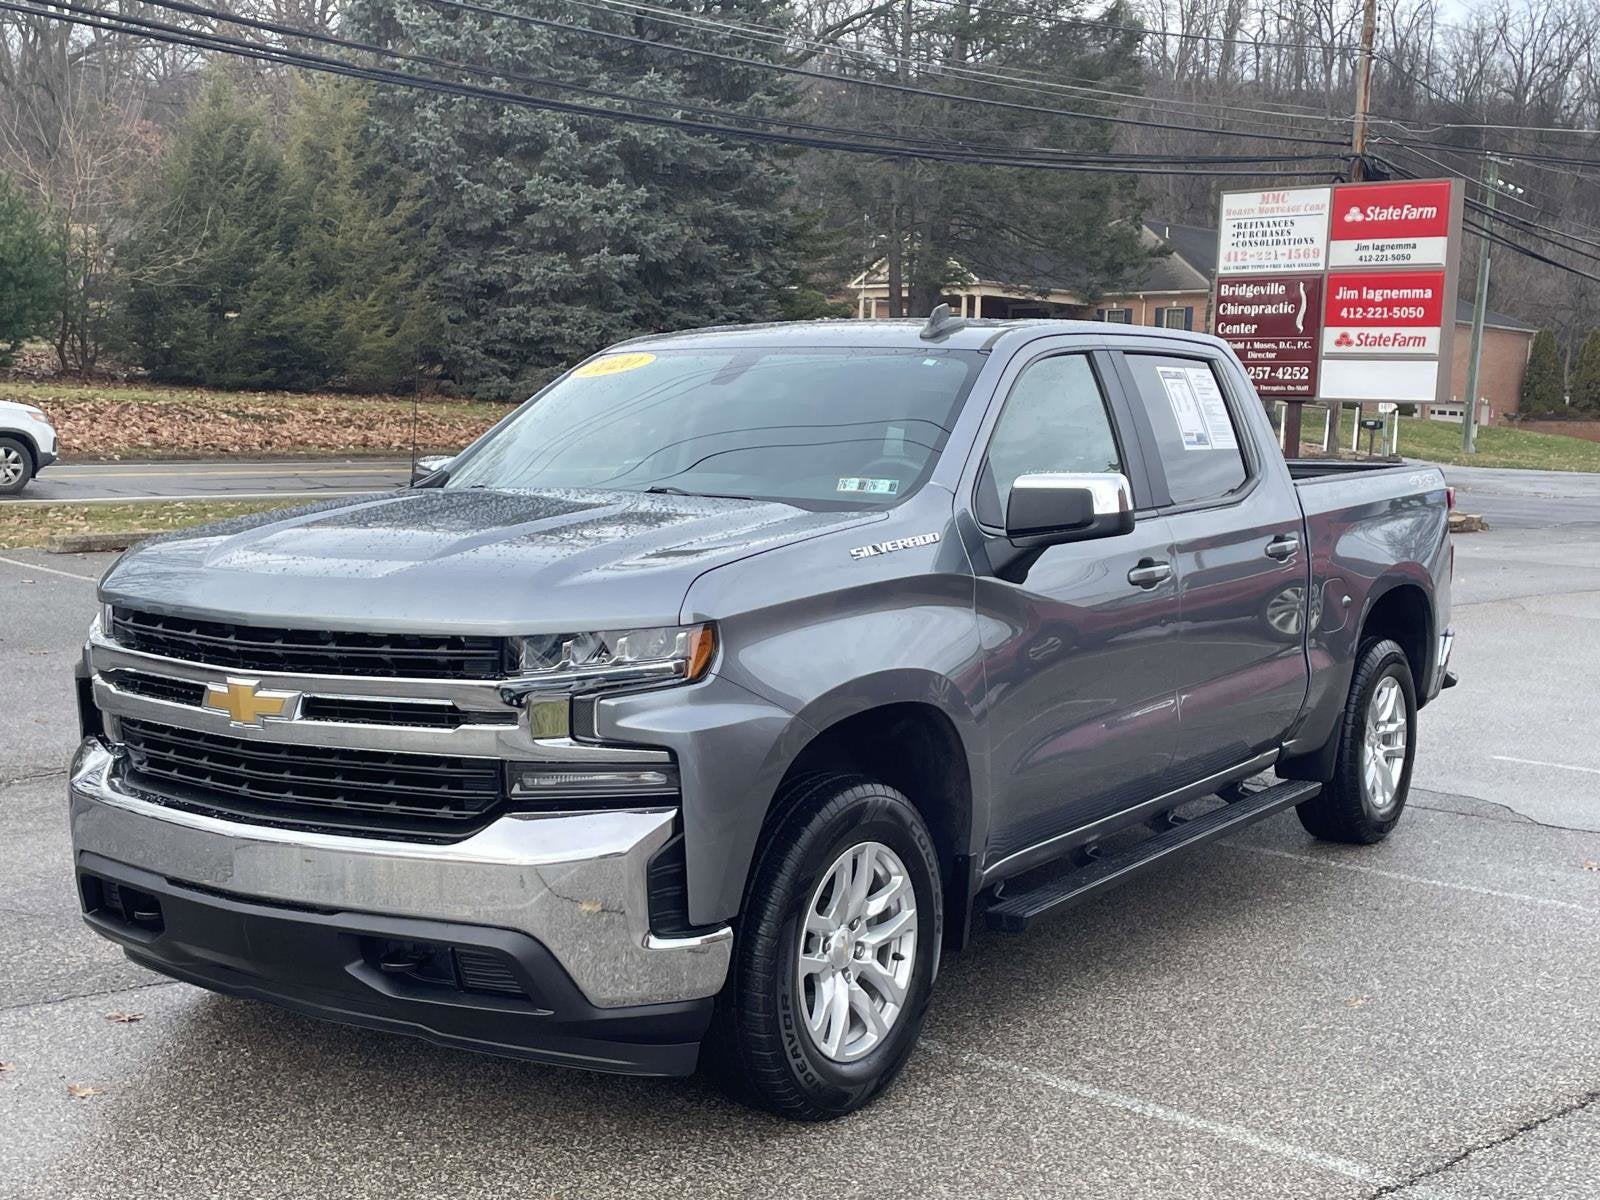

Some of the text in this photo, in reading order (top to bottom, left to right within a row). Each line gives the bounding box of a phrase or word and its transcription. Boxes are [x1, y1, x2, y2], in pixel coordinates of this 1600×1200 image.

[1354, 242, 1417, 252] Jim Iagnemma
[1224, 247, 1320, 262] 412-221-1569
[1358, 253, 1411, 262] 412-221-5050
[1221, 282, 1286, 298] Bridgeville
[1335, 286, 1433, 300] Jim Iagnemma
[1219, 302, 1296, 317] Chiropractic
[1340, 306, 1424, 319] 412-221-5050
[1218, 322, 1258, 334] Center
[1247, 351, 1277, 359] Director
[849, 532, 940, 560] SILVERADO
[781, 994, 828, 1092] NDEAVOR
